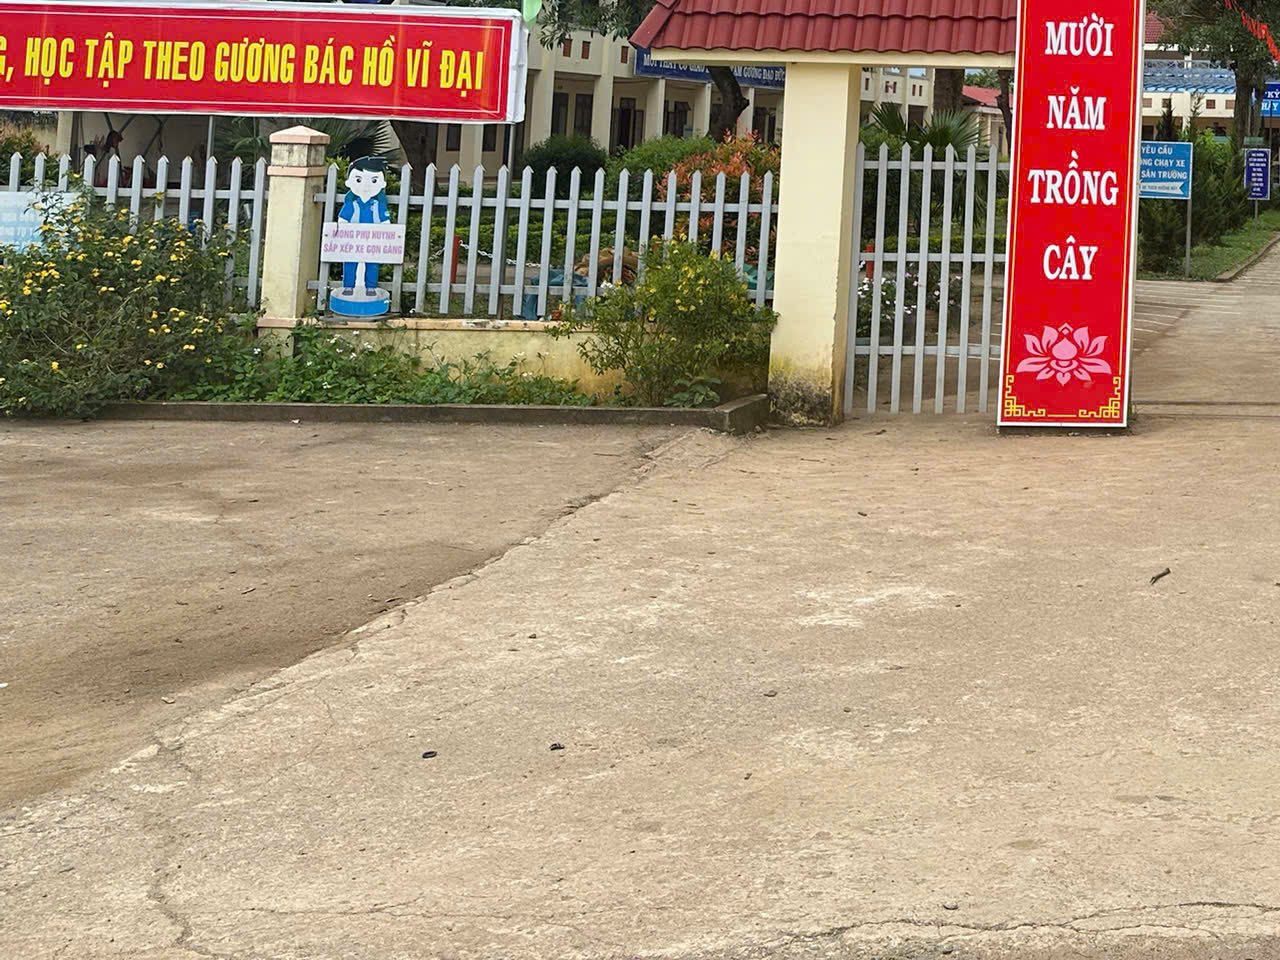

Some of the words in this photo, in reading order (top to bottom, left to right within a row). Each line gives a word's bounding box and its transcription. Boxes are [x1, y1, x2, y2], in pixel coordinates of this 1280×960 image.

[1044, 12, 1115, 58] MƯỜI
[24, 37, 76, 86] HỌC
[85, 31, 134, 88] TẬP
[143, 41, 206, 82] THEO
[214, 37, 297, 84] GƯƠNG
[303, 37, 354, 86] BÁC
[361, 35, 396, 87] HỒ
[406, 40, 433, 88] VĨ
[439, 49, 485, 97] ĐẠI
[1046, 85, 1107, 130] NĂM
[1027, 150, 1119, 206] TRỒNG
[1175, 159, 1186, 168] XE
[355, 244, 365, 253] XE
[1042, 235, 1099, 280] CÂY
